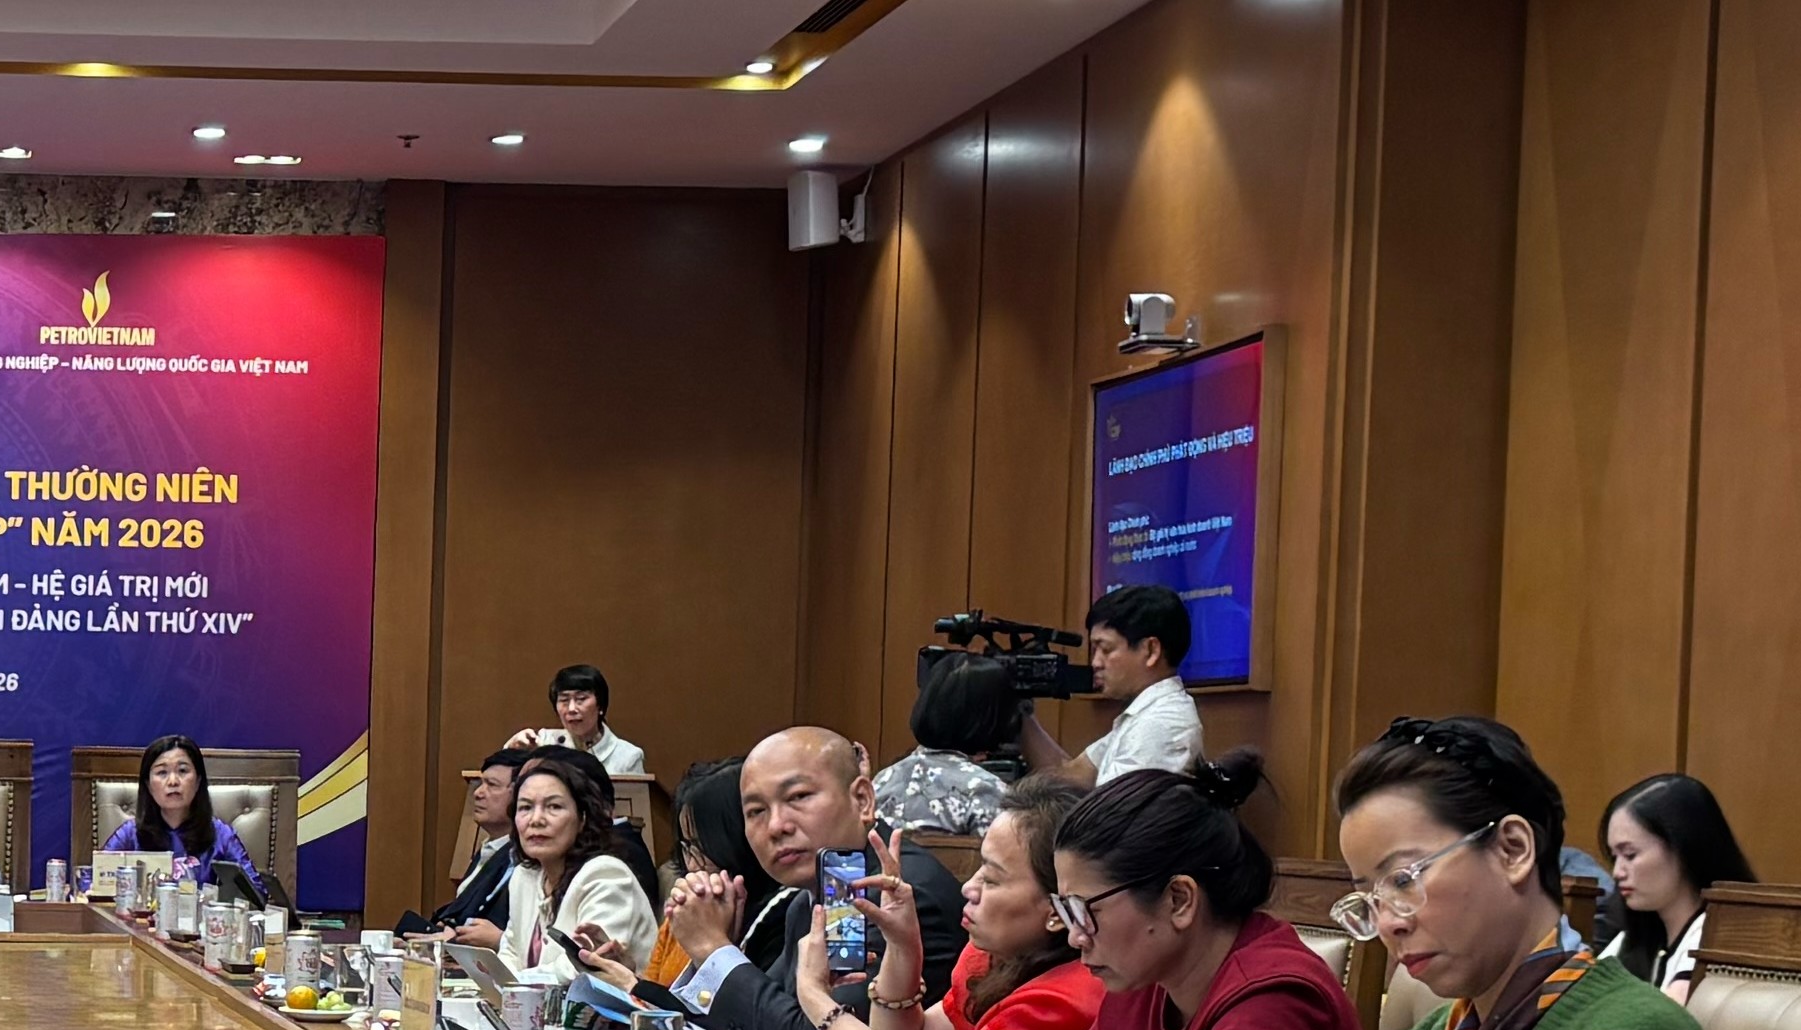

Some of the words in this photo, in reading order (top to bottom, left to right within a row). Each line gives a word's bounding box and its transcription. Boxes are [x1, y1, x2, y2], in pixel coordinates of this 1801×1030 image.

[39, 325, 156, 346] PETROVIETNAM
[4, 353, 60, 374] NGHIỆP
[71, 354, 115, 371] NĂNG
[116, 356, 167, 375] LƯỢNG
[168, 354, 209, 373] QUỐC
[210, 358, 237, 373] GIA
[238, 356, 273, 377] VIỆT
[274, 360, 309, 374] NAM
[4, 464, 148, 502] THƯỜNG
[155, 466, 238, 504] NIÊN
[31, 510, 110, 547] NĂM
[117, 518, 204, 549] 2026
[31, 568, 66, 602] HỆ
[70, 570, 113, 598] GIÁ
[118, 575, 159, 603] TRỊ
[164, 571, 208, 598] MỚI
[11, 603, 81, 632] ĐẢNG
[86, 602, 139, 633] LẦN
[144, 607, 199, 634] THỨ
